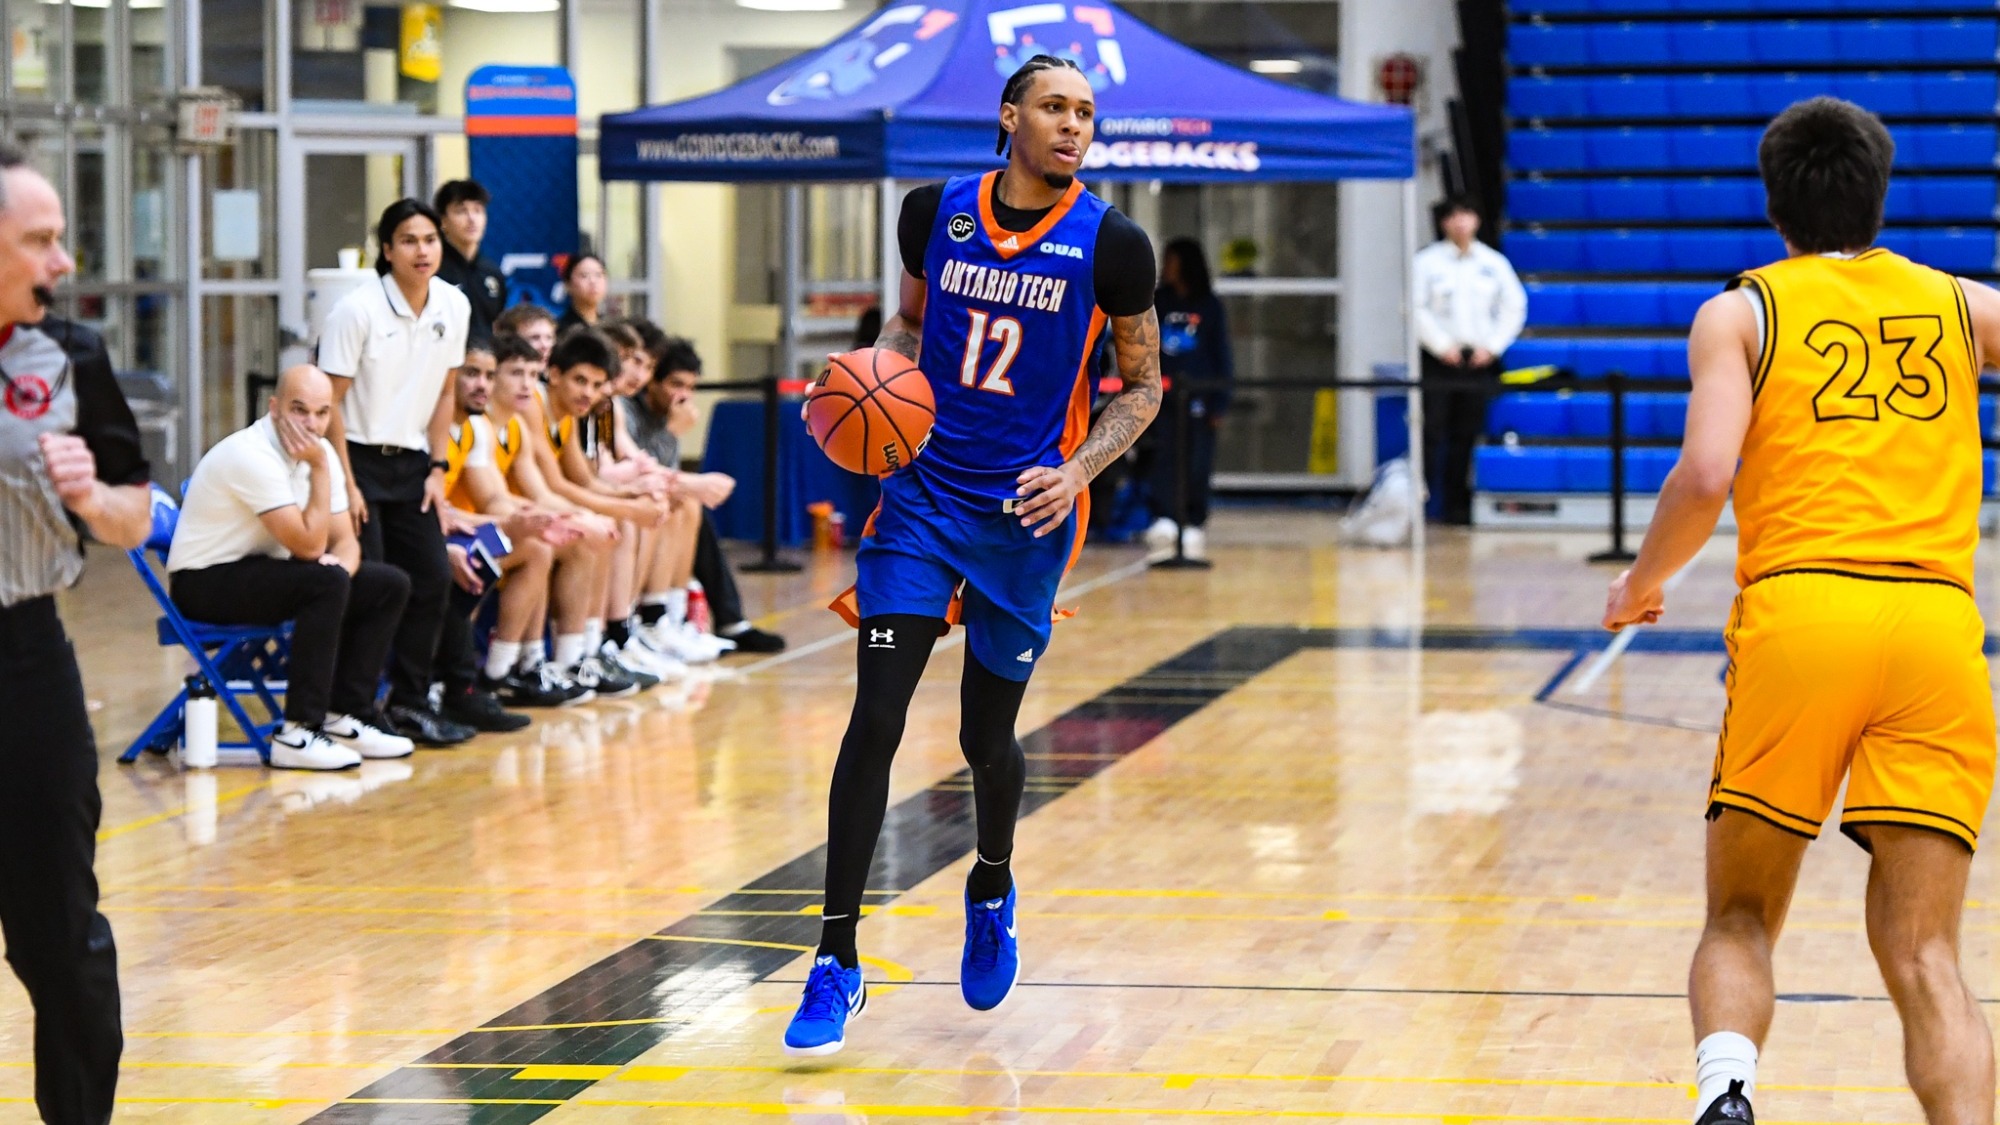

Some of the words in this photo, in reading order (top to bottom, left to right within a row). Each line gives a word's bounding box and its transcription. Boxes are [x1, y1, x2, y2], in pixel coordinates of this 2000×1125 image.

[1080, 141, 1261, 171] DGEBACKS
[952, 218, 973, 233] GF
[1040, 242, 1083, 259] OUA
[940, 258, 1019, 305] ONTARIO
[1017, 273, 1067, 313] TECH
[960, 307, 1024, 396] 12
[1804, 314, 1947, 422] 23
